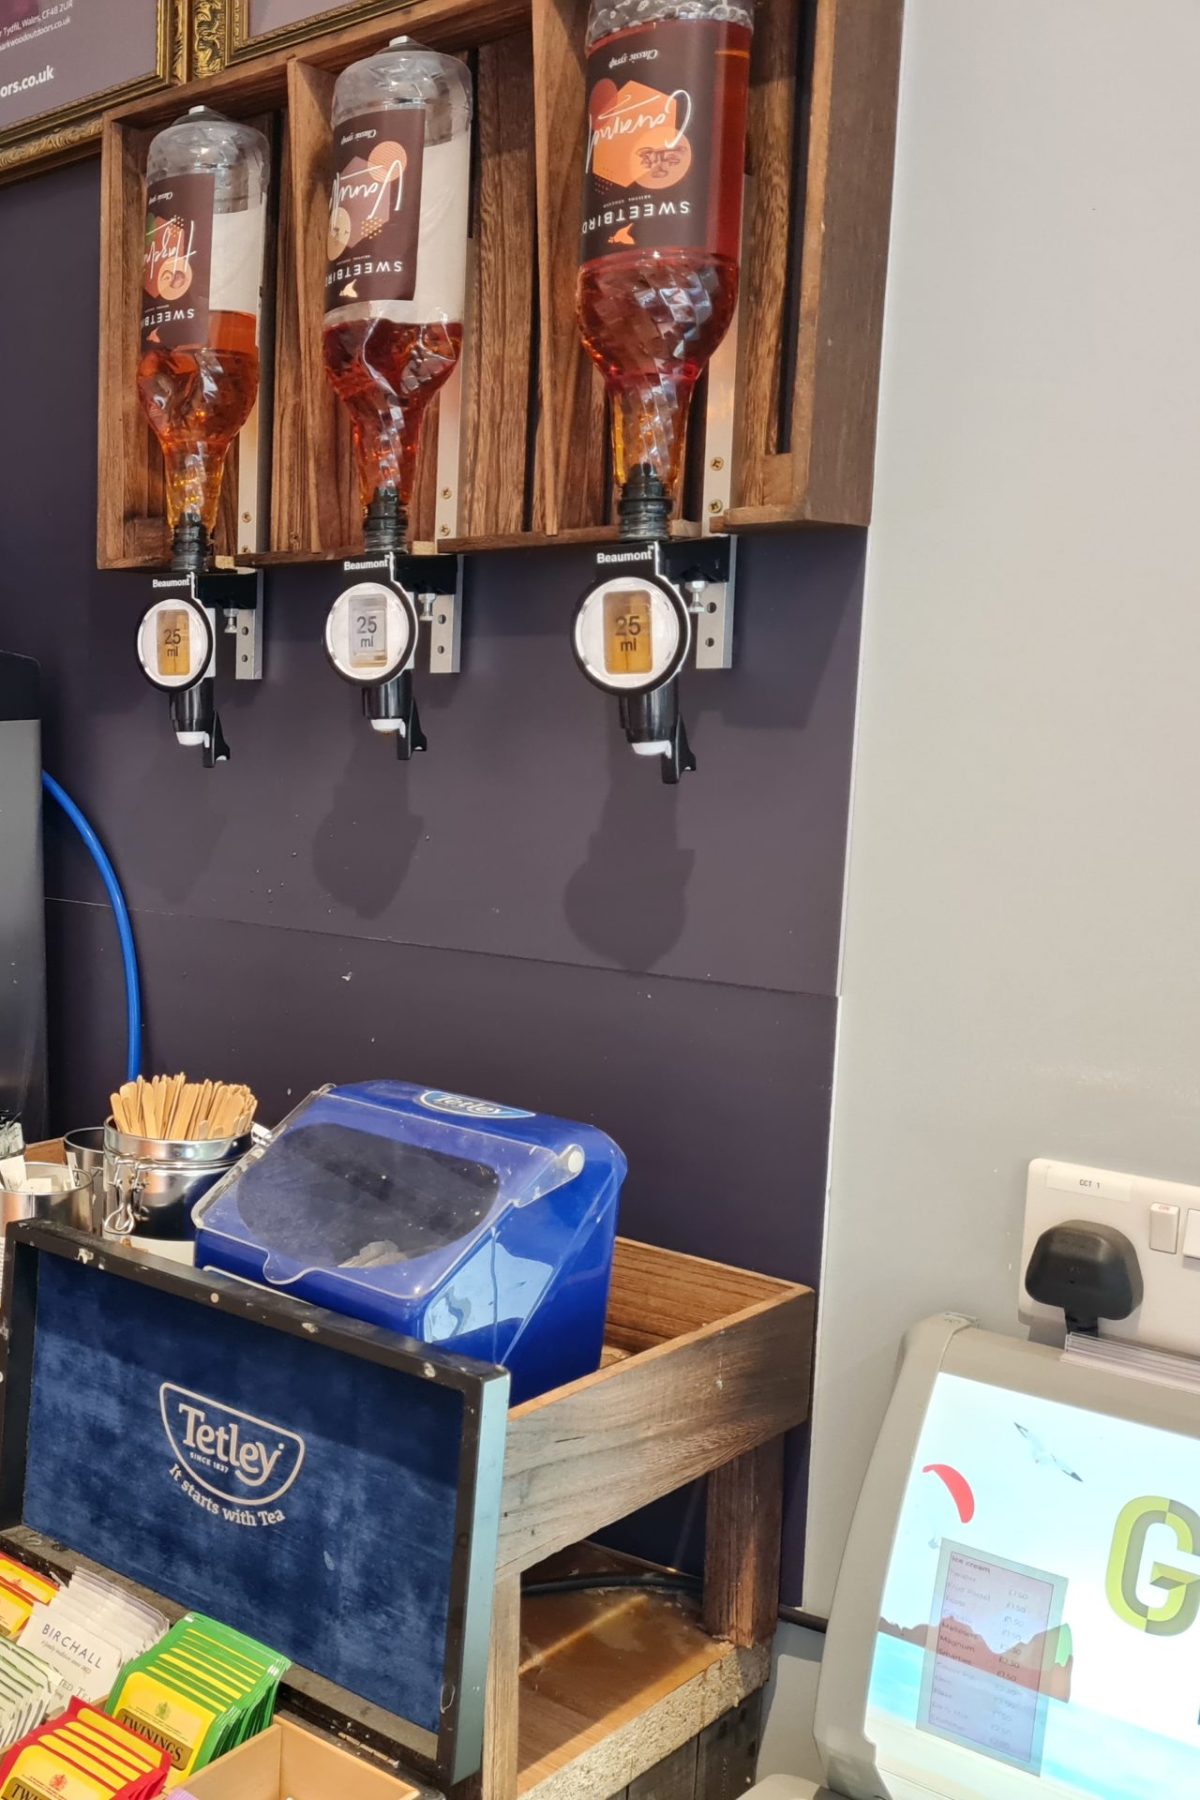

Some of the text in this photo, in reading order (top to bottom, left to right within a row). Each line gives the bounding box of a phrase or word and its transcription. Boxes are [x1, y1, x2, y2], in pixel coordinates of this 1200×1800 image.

[585, 89, 692, 175] Caramel
[582, 200, 691, 234] SWEETBIRD
[343, 559, 389, 570] Beaumont
[596, 550, 652, 564] Beaumont
[152, 578, 190, 588] Beaumont
[356, 616, 377, 634] 25
[615, 615, 642, 636] 25
[164, 628, 182, 645] 25
[360, 637, 374, 648] ml
[620, 638, 637, 652] ml
[166, 646, 179, 657] ml
[178, 1402, 286, 1487] Tetley
[169, 1463, 286, 1527] It starts with Tea
[41, 1623, 103, 1669] BIRCHALL
[122, 1714, 184, 1762] TWININGS
